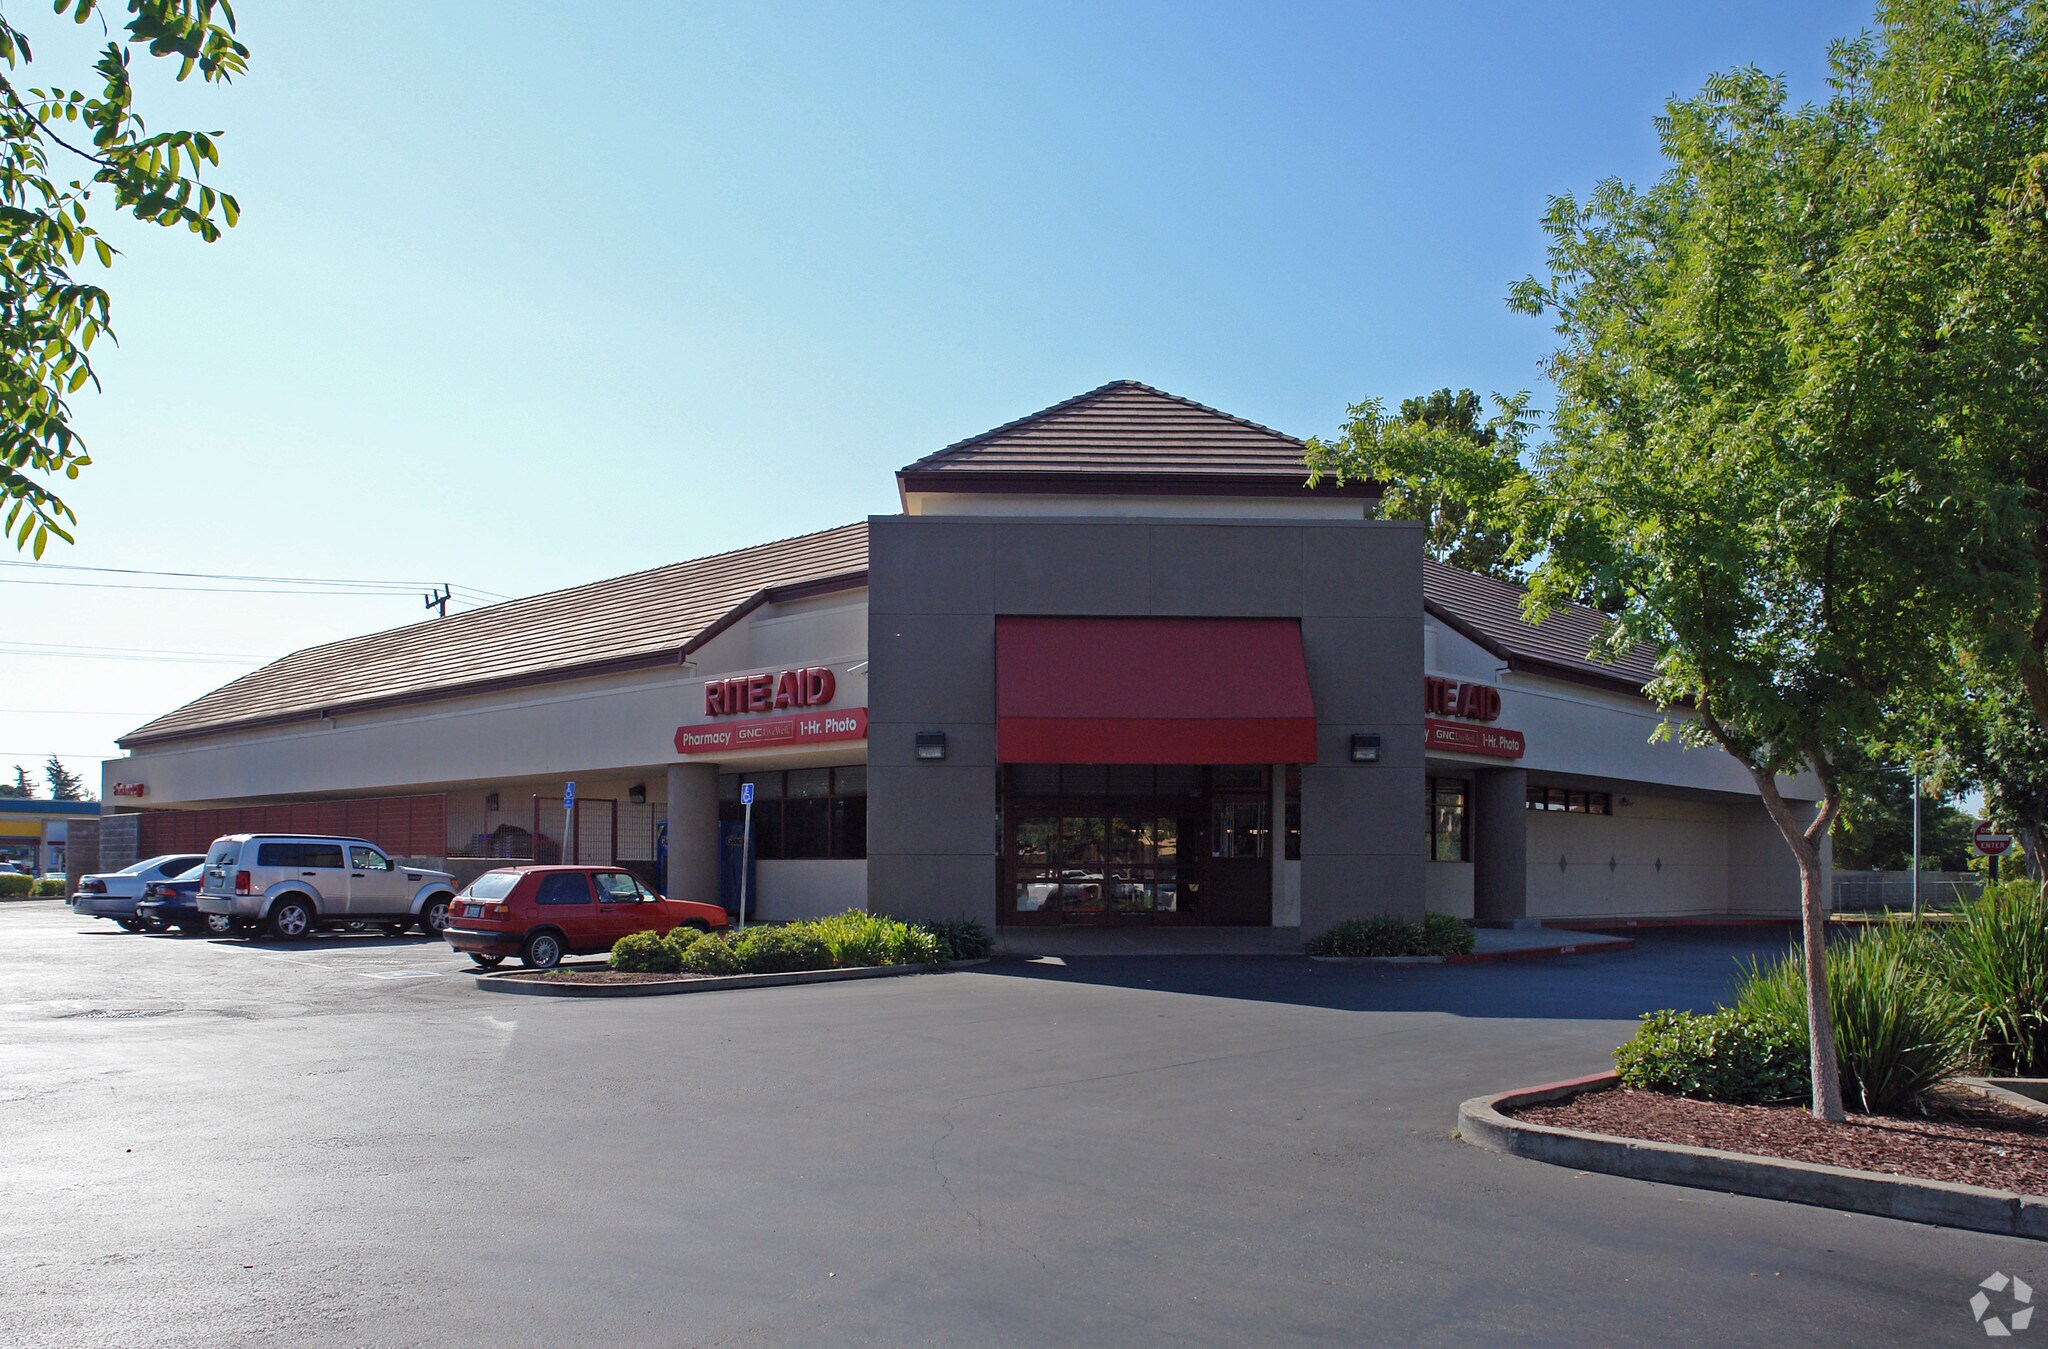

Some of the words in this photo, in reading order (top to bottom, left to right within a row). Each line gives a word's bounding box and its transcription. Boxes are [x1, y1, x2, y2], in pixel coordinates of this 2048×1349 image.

[705, 673, 773, 716] RITE
[774, 666, 836, 709] AID
[1425, 676, 1458, 715] ITE
[1457, 684, 1501, 722] AID
[683, 731, 731, 746] Pharmacy
[739, 727, 763, 739] GNC
[800, 720, 822, 735] 1-Hr.
[825, 717, 857, 733] Photo
[1436, 729, 1455, 740] GNC
[1482, 733, 1498, 749] 1-Hr.
[1500, 736, 1520, 751] Photo
